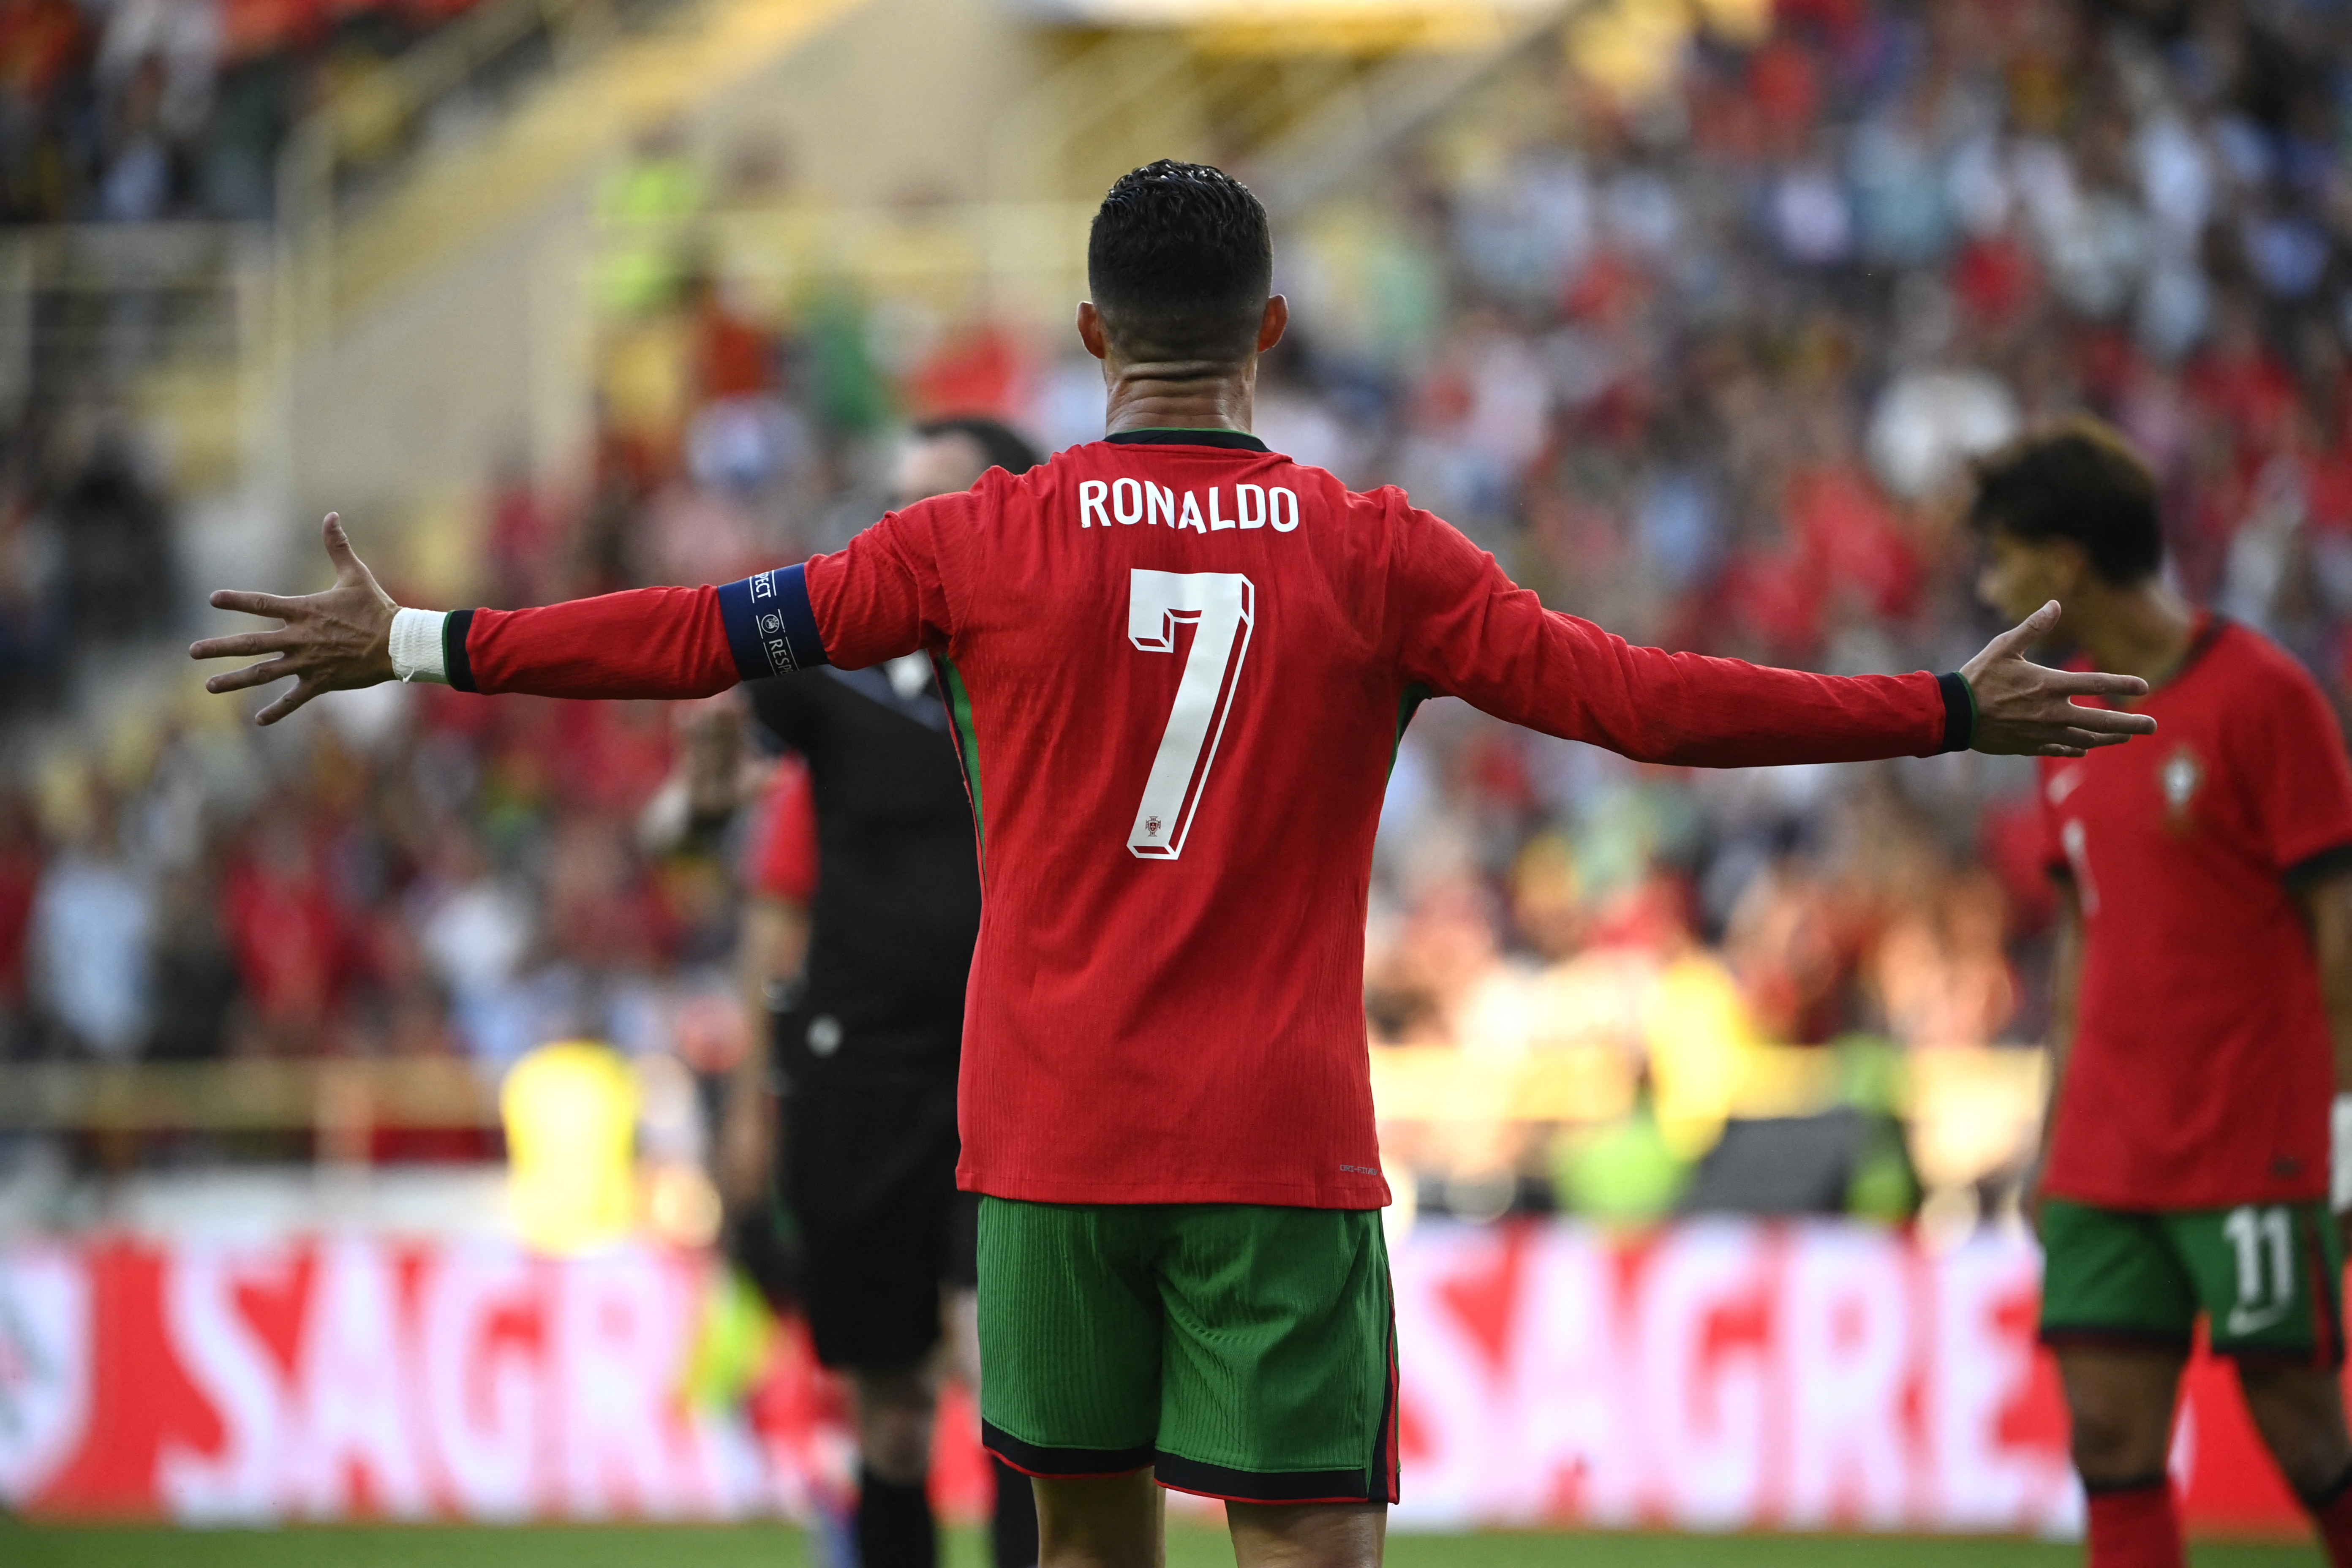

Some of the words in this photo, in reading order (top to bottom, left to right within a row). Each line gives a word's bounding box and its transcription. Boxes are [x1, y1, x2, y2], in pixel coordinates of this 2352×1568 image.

[755, 572, 771, 598] PECT
[1080, 478, 1298, 534] RONALDO
[1127, 568, 1254, 860] 7
[2224, 1205, 2294, 1307] 11
[154, 1227, 777, 1525] SAGR
[1388, 1214, 2195, 1533] SAGRE
